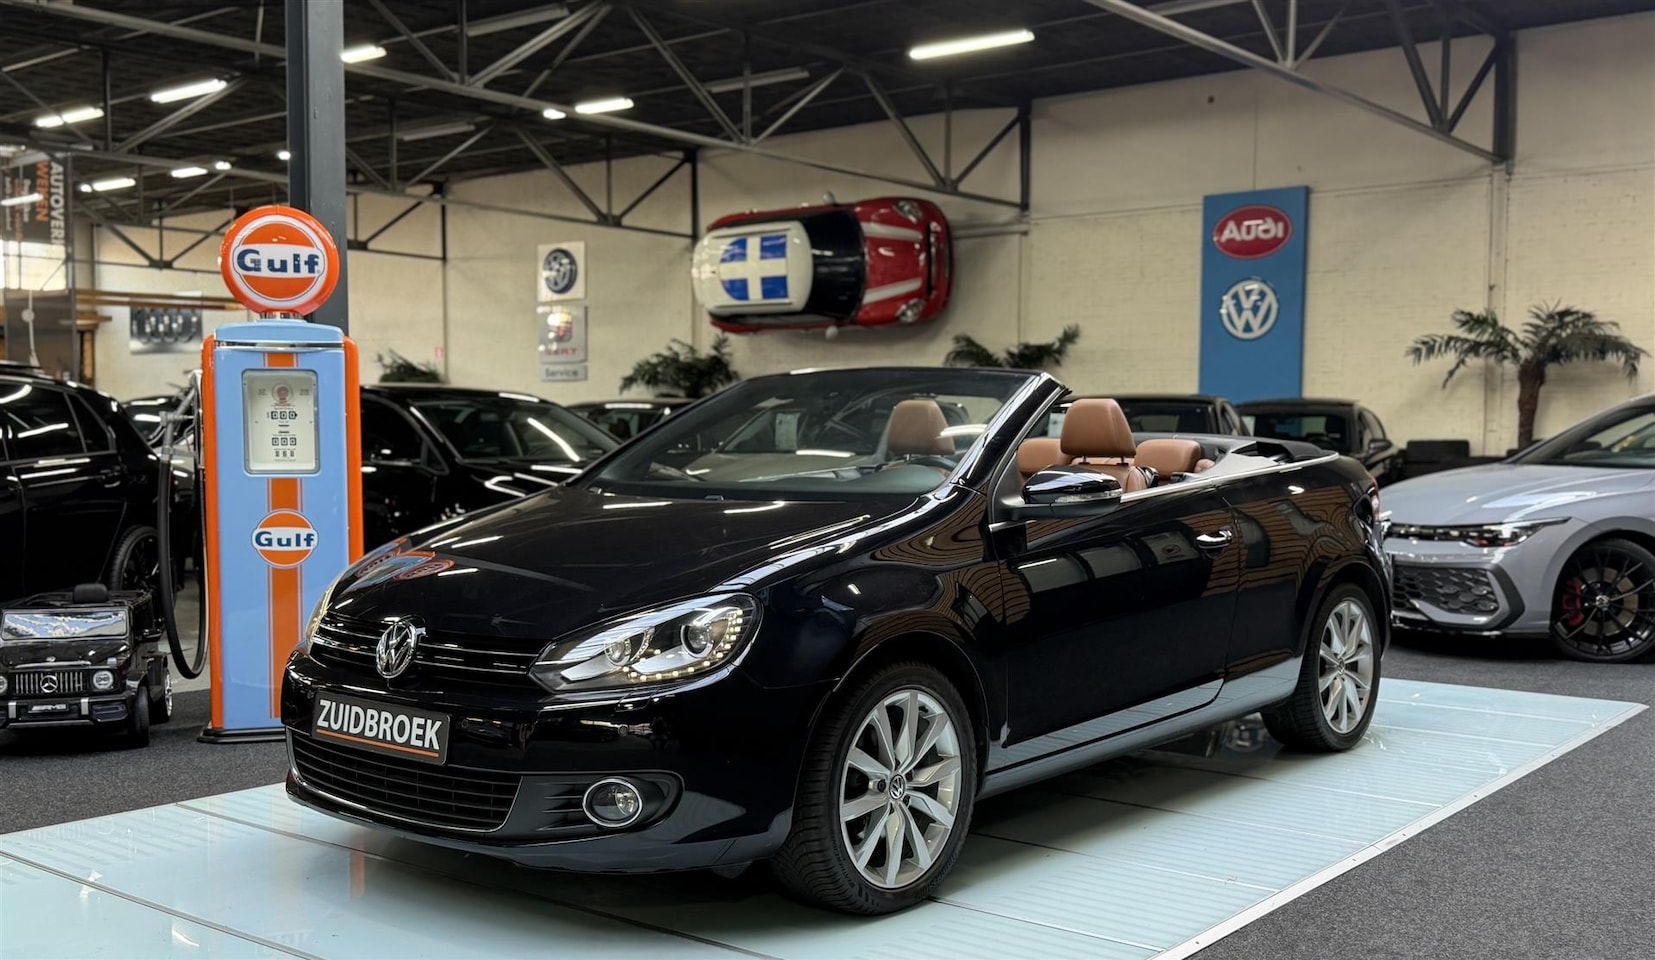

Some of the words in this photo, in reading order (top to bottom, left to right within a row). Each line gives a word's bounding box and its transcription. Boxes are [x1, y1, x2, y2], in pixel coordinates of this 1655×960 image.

[237, 249, 319, 273] Gulf
[255, 531, 314, 548] Gulf
[317, 699, 442, 750] ZUIDBROEK
